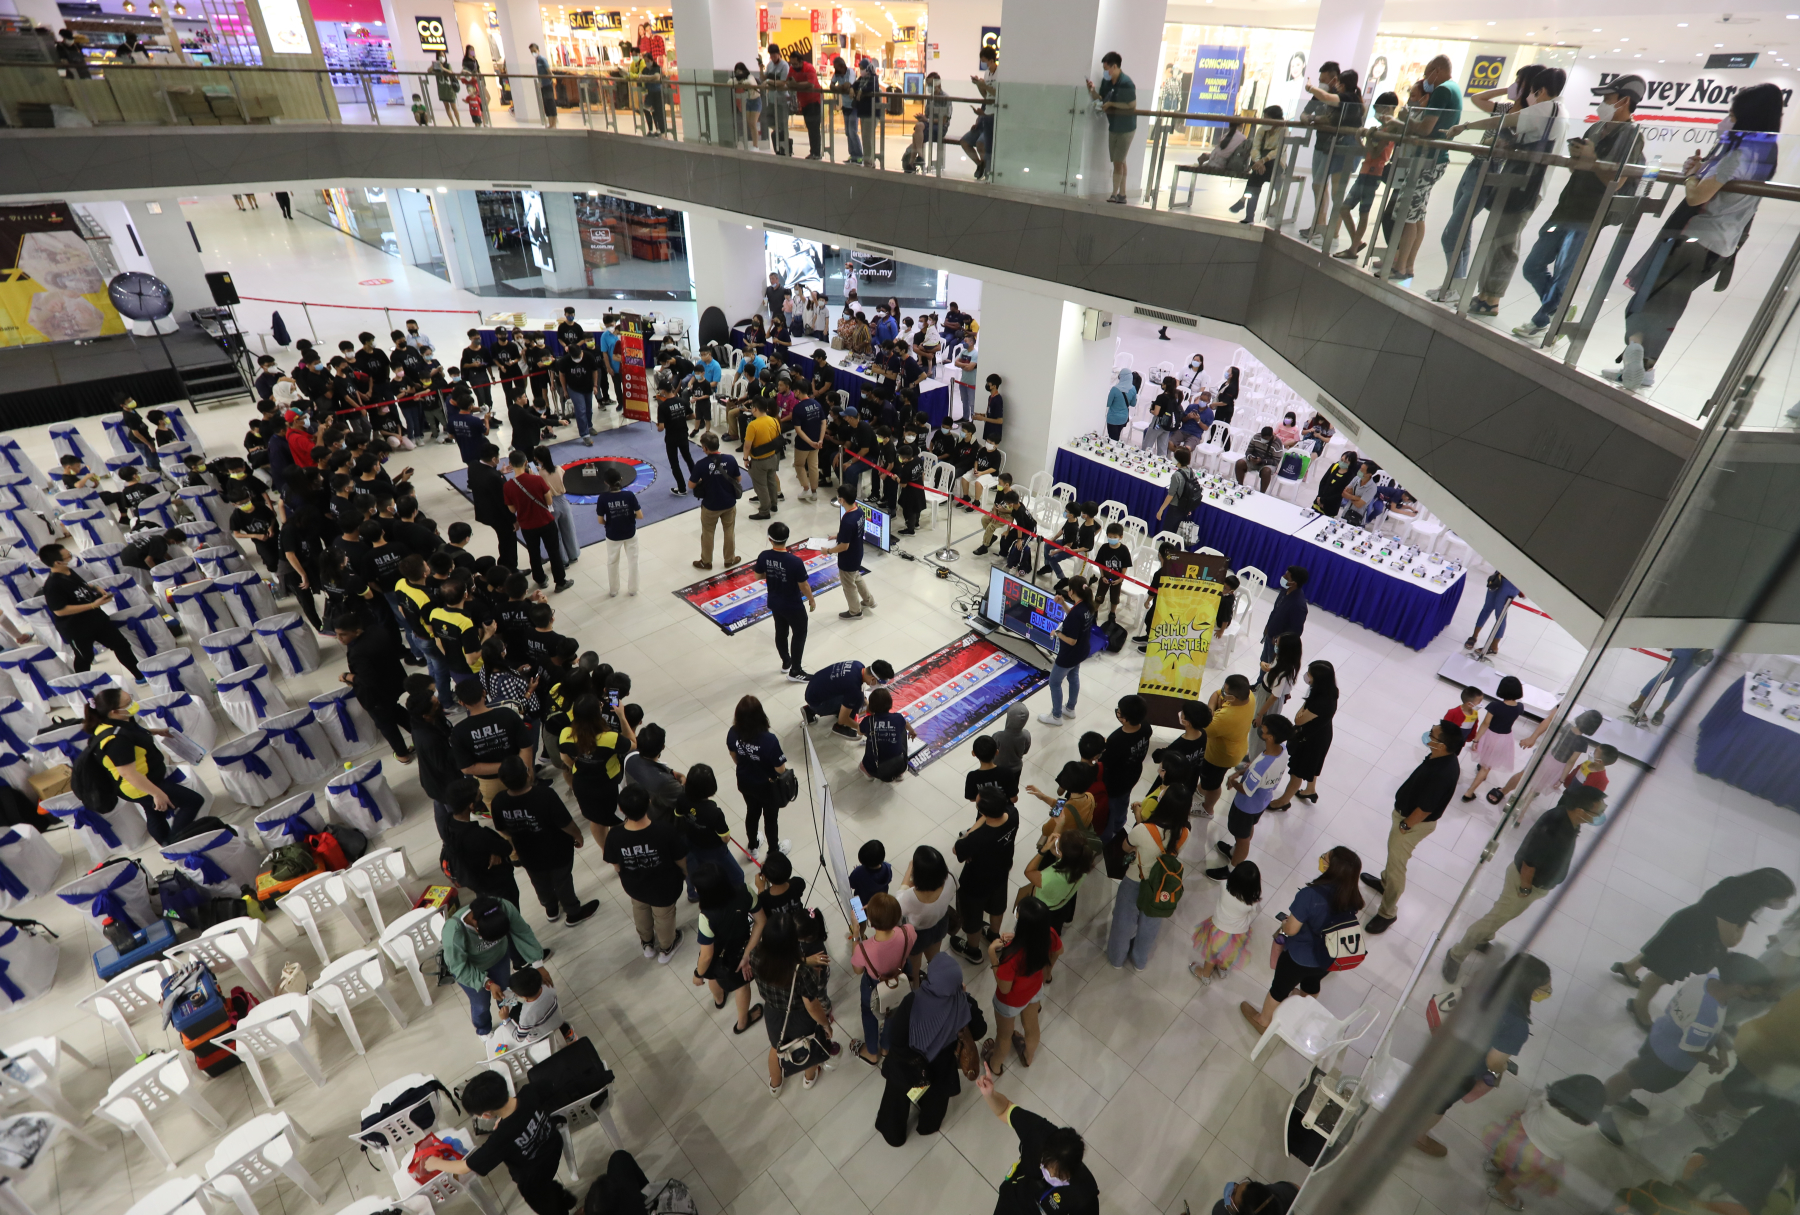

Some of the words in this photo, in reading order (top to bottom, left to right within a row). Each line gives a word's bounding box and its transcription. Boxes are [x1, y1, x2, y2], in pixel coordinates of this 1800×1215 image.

[570, 14, 594, 28] SALE
[597, 13, 622, 28] SALE
[651, 18, 674, 32] SALE
[417, 20, 444, 37] CO
[893, 29, 915, 41] SALE
[820, 34, 838, 45] SALE
[1474, 61, 1502, 80] CO
[1470, 78, 1499, 88] LEGACY
[1593, 73, 1690, 107] Hvey
[1688, 78, 1793, 108] Norn
[853, 268, 893, 279] c.com.my
[866, 521, 879, 537] BLUE
[1004, 579, 1020, 598] 05
[1021, 587, 1046, 611] 000
[729, 617, 748, 631] BLUE
[1155, 623, 1188, 637] SUMO
[1161, 637, 1208, 653] MASTER
[471, 723, 506, 740] N.R.L.
[910, 748, 933, 768] BLUE
[502, 809, 536, 820] N.R.L.
[621, 843, 658, 857] N.R.L.
